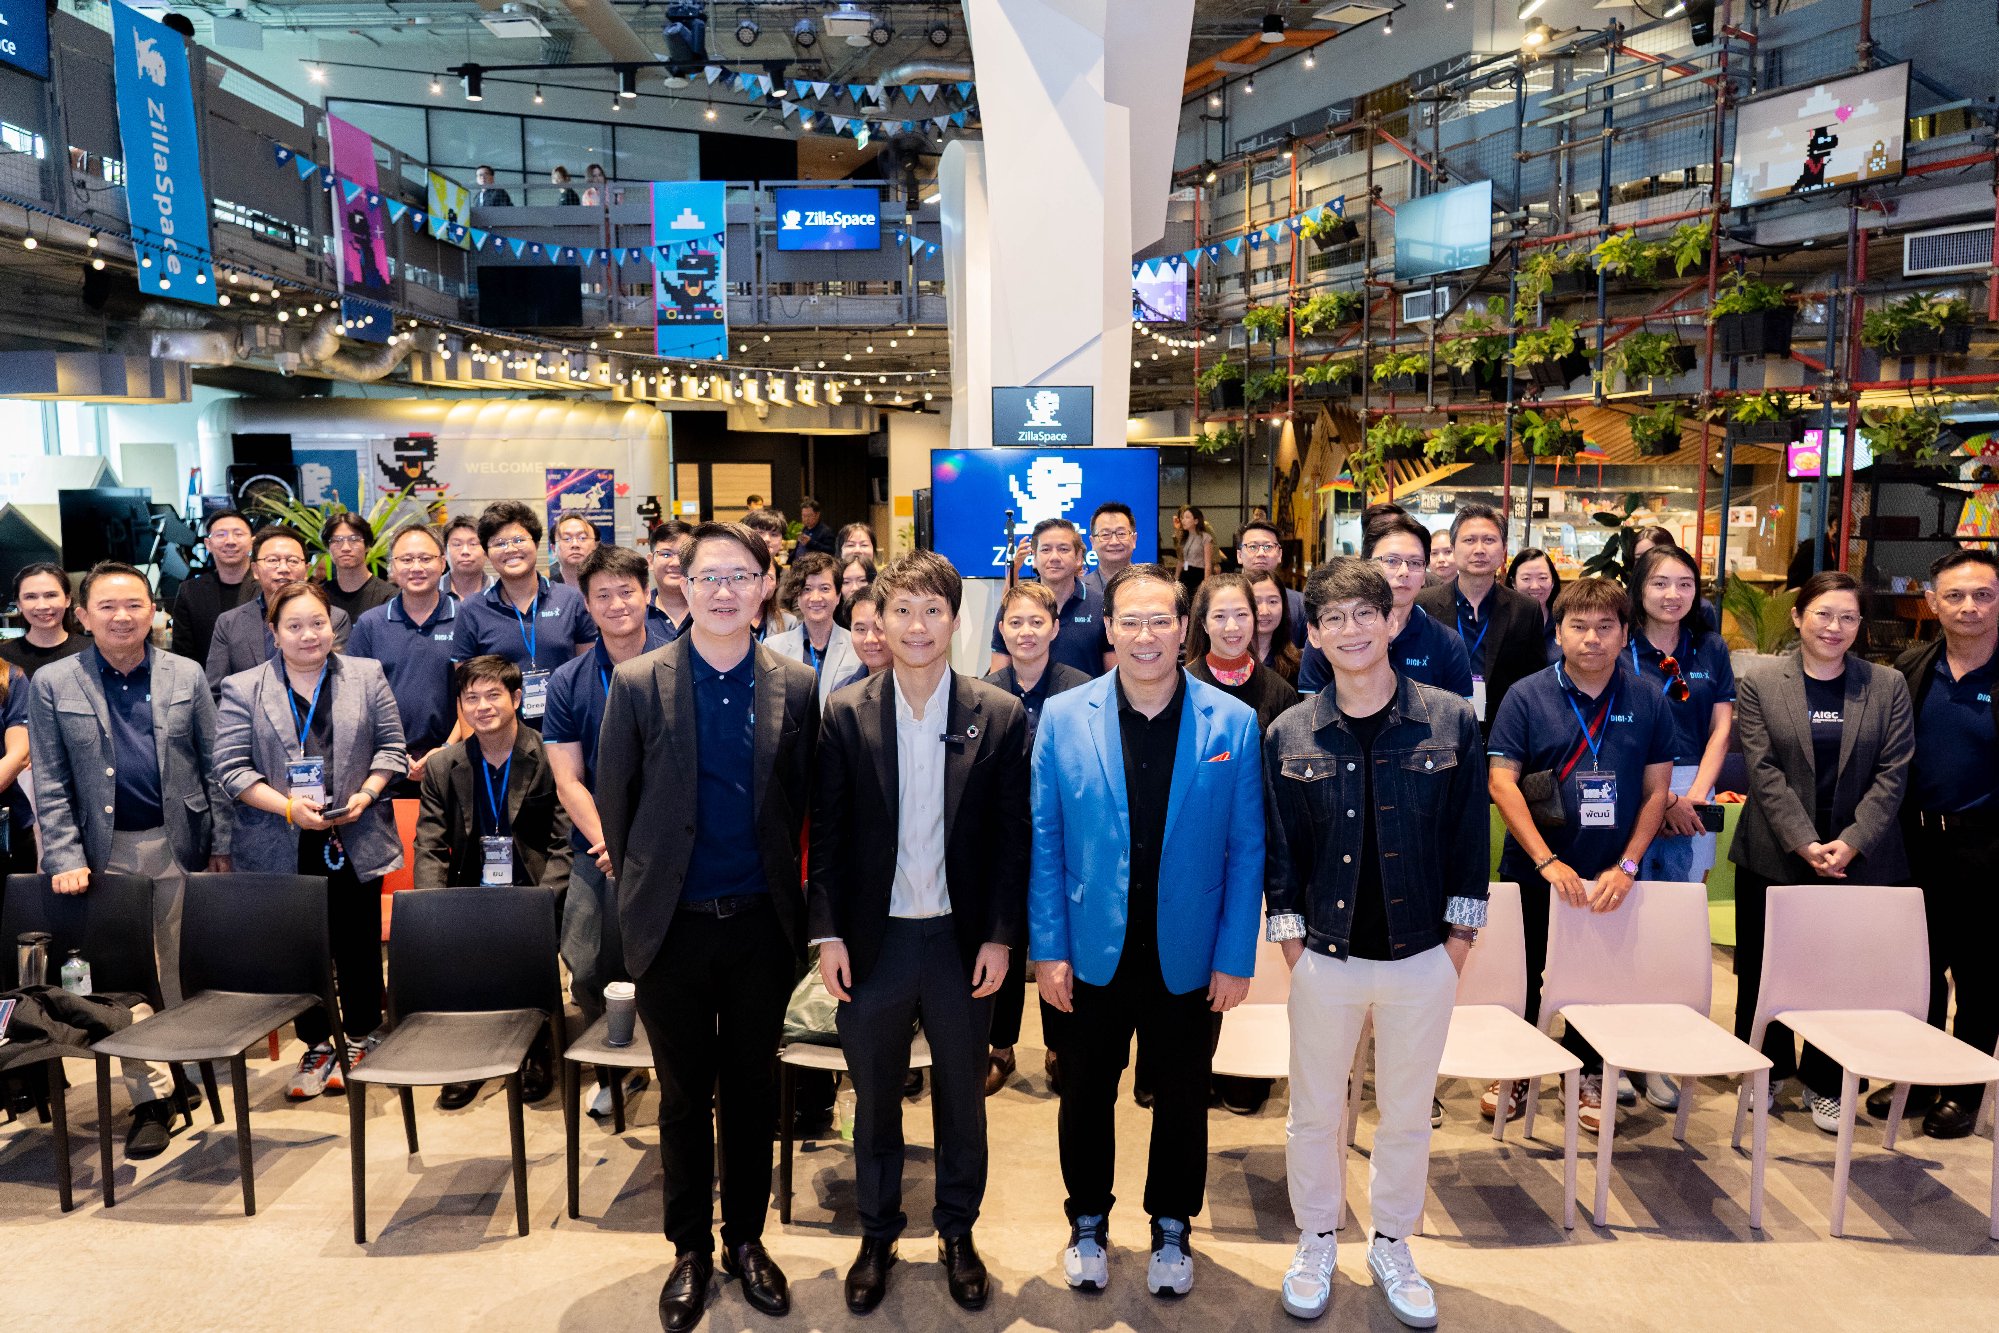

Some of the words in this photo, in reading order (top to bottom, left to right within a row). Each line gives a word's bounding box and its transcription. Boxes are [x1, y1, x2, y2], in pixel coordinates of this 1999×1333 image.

[147, 97, 182, 275] ZillaSpace
[804, 211, 876, 229] ZillaSpace
[1018, 431, 1068, 443] ZillaSpace
[466, 462, 544, 474] WELCOME
[1421, 493, 1441, 502] PICK
[1443, 494, 1456, 503] UP
[1515, 503, 1544, 512] ORER
[541, 607, 560, 617] DIGI-X
[1406, 656, 1429, 666] DIGI-X
[1610, 713, 1634, 723] DIGI-X
[1813, 711, 1839, 719] AIGC
